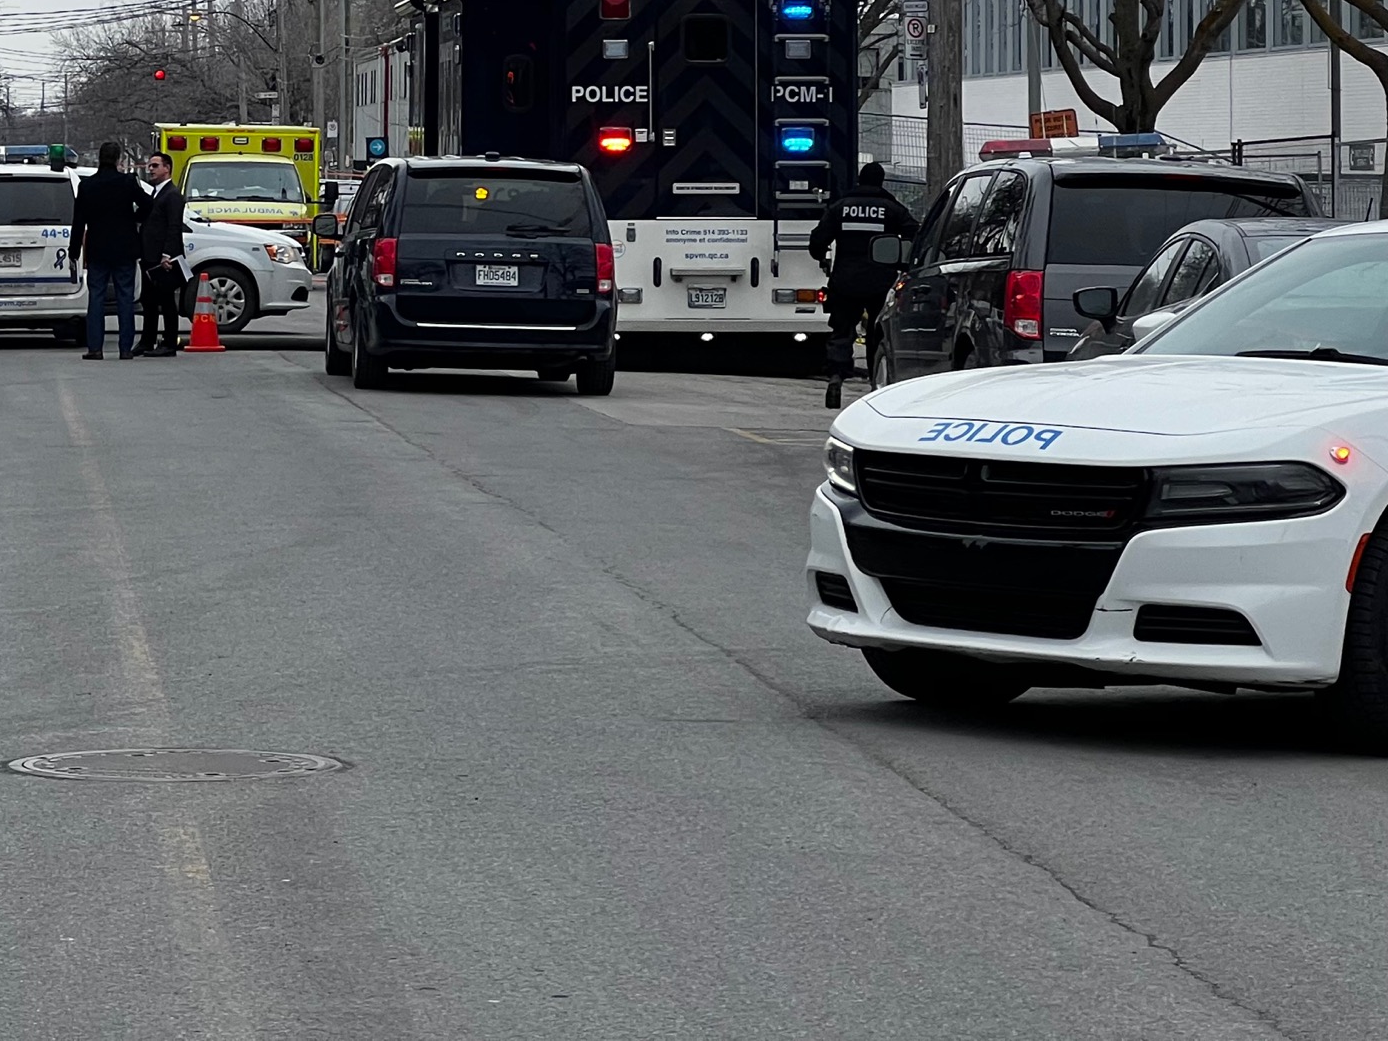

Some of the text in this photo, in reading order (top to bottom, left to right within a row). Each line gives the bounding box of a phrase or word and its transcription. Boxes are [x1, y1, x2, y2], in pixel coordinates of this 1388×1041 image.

[571, 85, 648, 103] POLICE
[842, 205, 886, 219] POLICE
[41, 229, 70, 239] 44-8
[685, 252, 729, 260] spvm.qc.ca
